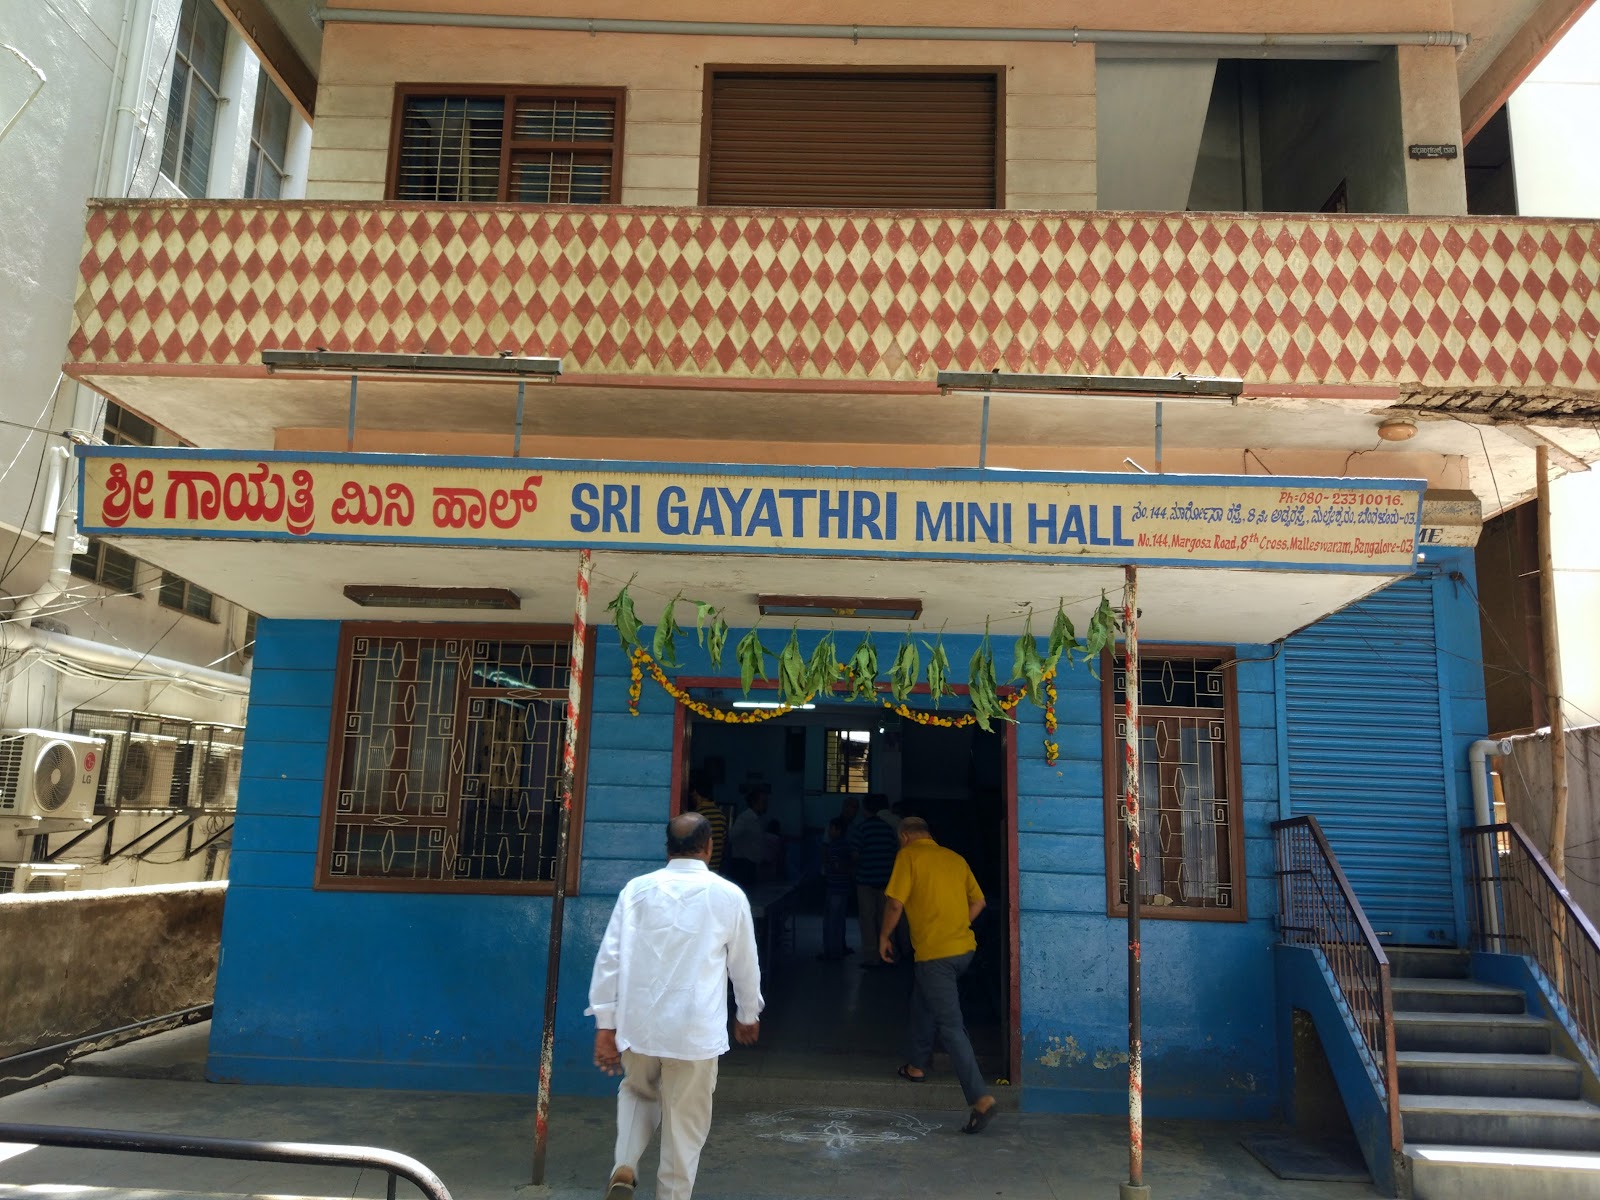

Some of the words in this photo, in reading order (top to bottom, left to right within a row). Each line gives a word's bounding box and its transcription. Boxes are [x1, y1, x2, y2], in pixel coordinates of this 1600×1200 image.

[102, 463, 154, 527] ಶ್ರೀ
[164, 463, 315, 535] ಗಾಯತ್ರಿ
[331, 481, 414, 526] ಮಿನಿ
[432, 475, 543, 529] ಹಾಲ್
[570, 482, 640, 534] SRI
[657, 485, 898, 541] GAYATHRI
[915, 501, 1012, 545] MINI
[1028, 503, 1134, 547] HALL
[82, 774, 92, 785] LG
